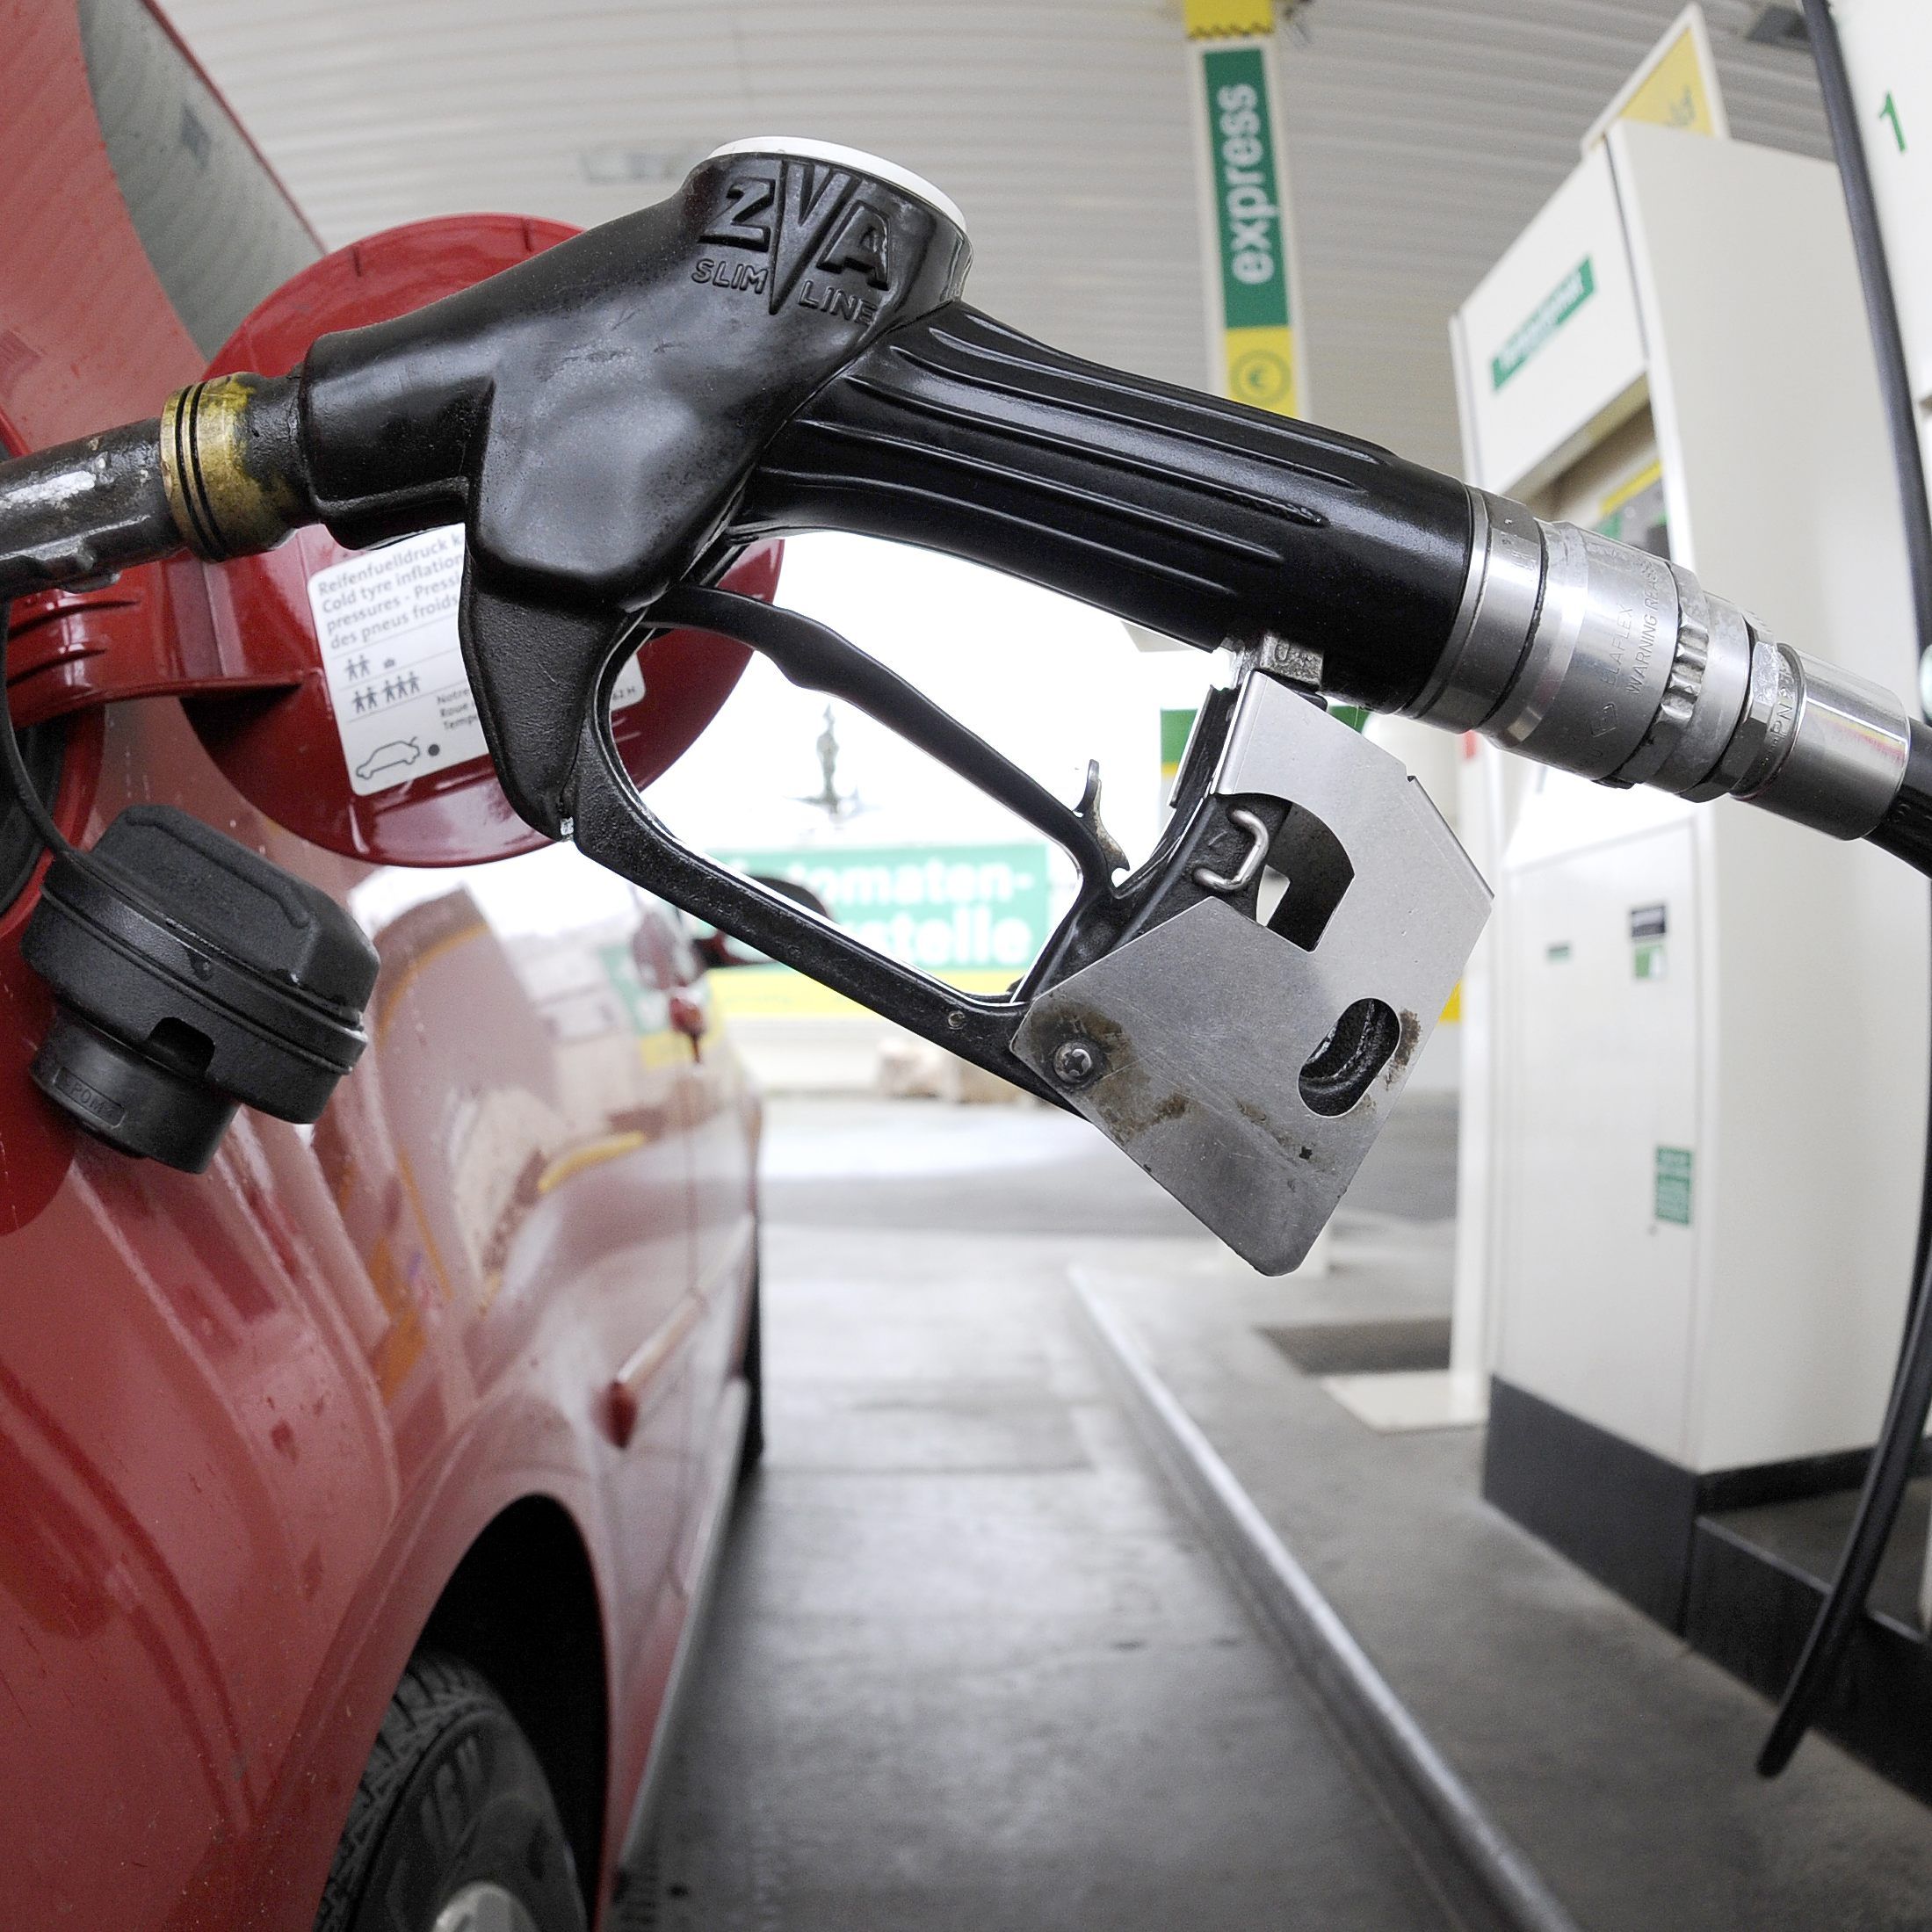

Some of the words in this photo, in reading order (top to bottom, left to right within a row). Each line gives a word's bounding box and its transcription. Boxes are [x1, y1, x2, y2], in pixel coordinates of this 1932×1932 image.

[1878, 91, 1906, 153] 1
[1216, 83, 1280, 286] express
[698, 161, 891, 315] ZVA
[691, 257, 770, 295] SLIM
[798, 279, 879, 327] LINE
[317, 536, 448, 597] Reifenfuelldruck
[322, 591, 358, 614] Cold
[361, 578, 393, 602] tyre
[396, 554, 464, 588] inflation
[326, 596, 402, 637] pressures
[414, 572, 461, 599] Pressi
[330, 633, 358, 651] des
[361, 612, 409, 643] pneus
[412, 593, 459, 620] froids
[1602, 603, 1634, 687] ELAFLEX
[1626, 613, 1659, 695] WARNING
